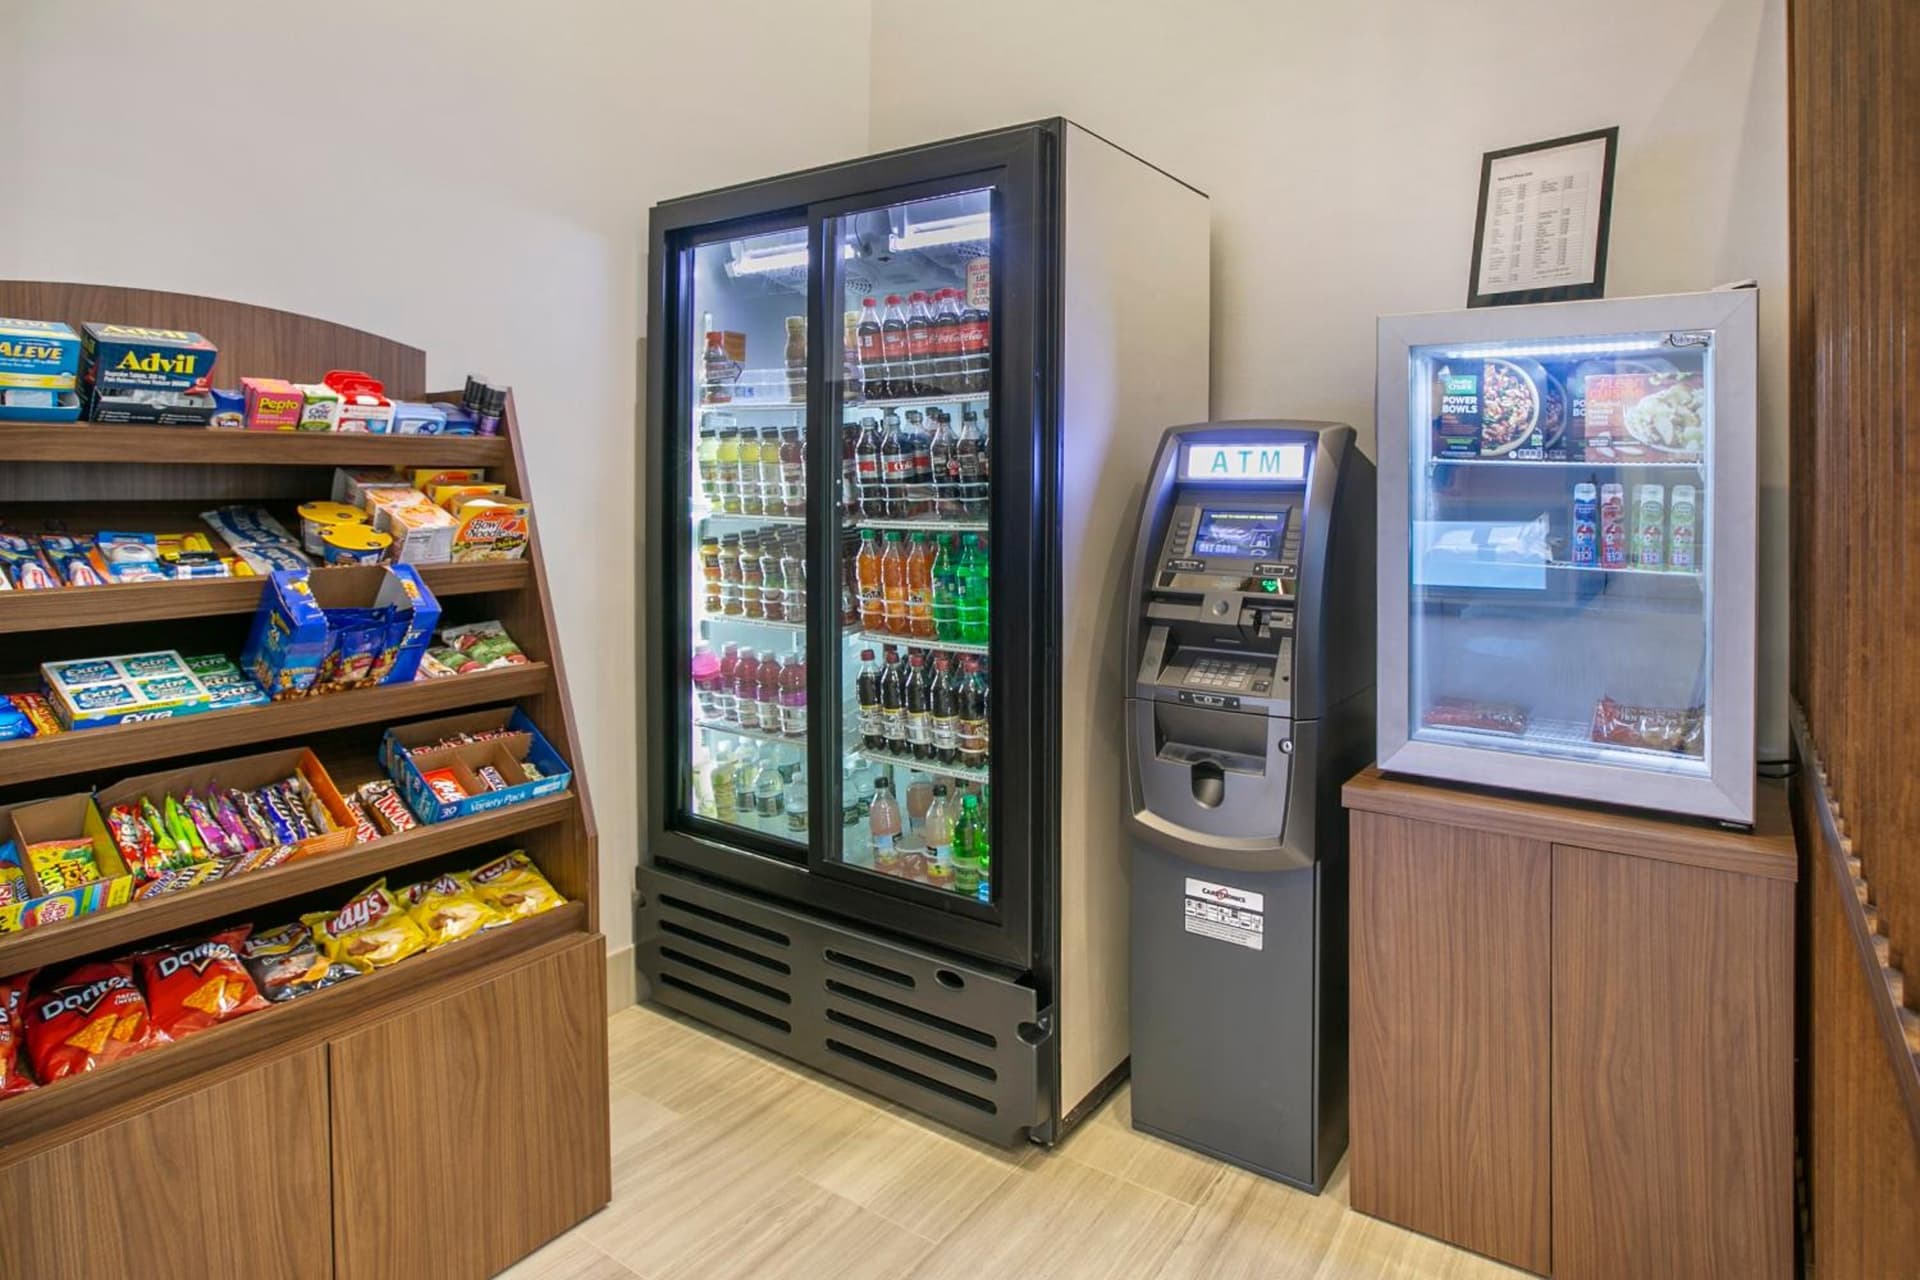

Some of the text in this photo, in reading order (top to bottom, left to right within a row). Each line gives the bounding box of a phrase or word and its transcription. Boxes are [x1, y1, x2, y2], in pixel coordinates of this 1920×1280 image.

[0, 342, 63, 360] ALEVE
[115, 350, 194, 374] Advil
[260, 397, 298, 410] Pepto
[1443, 396, 1478, 405] POWER
[1442, 405, 1478, 414] BOWLS
[1211, 450, 1281, 473] ATM
[472, 518, 504, 529] Bowl
[191, 657, 226, 669] xtra
[80, 684, 125, 699] Extra
[471, 799, 501, 813] Variety
